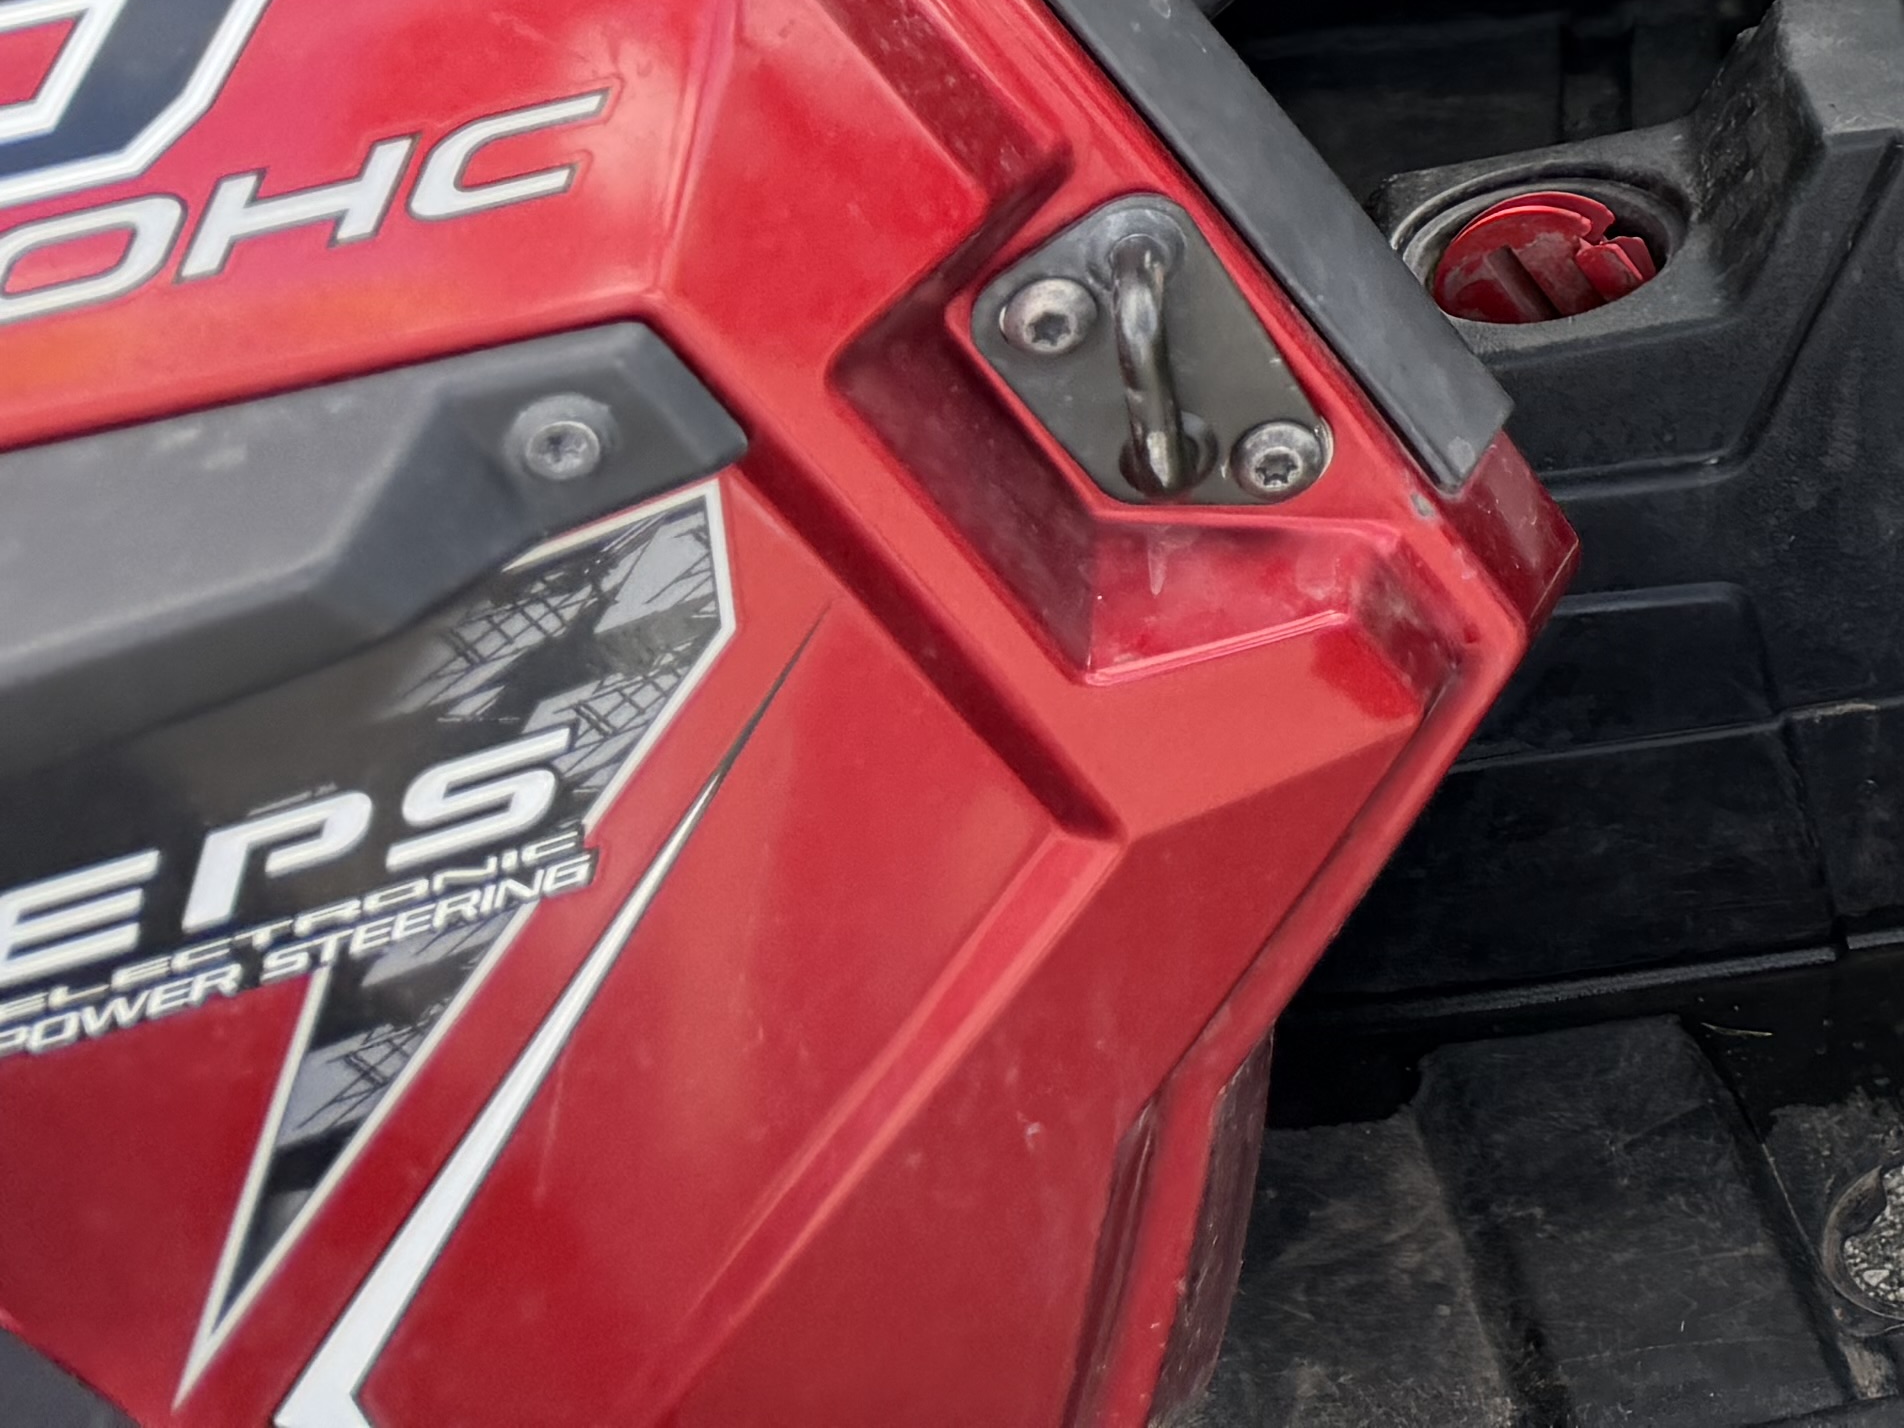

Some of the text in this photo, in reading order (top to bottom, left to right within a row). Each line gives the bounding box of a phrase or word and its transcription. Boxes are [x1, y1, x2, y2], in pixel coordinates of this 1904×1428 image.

[0, 726, 576, 990] EPS
[0, 827, 583, 1022] ELECTRONIC
[260, 853, 597, 986] STEERING
